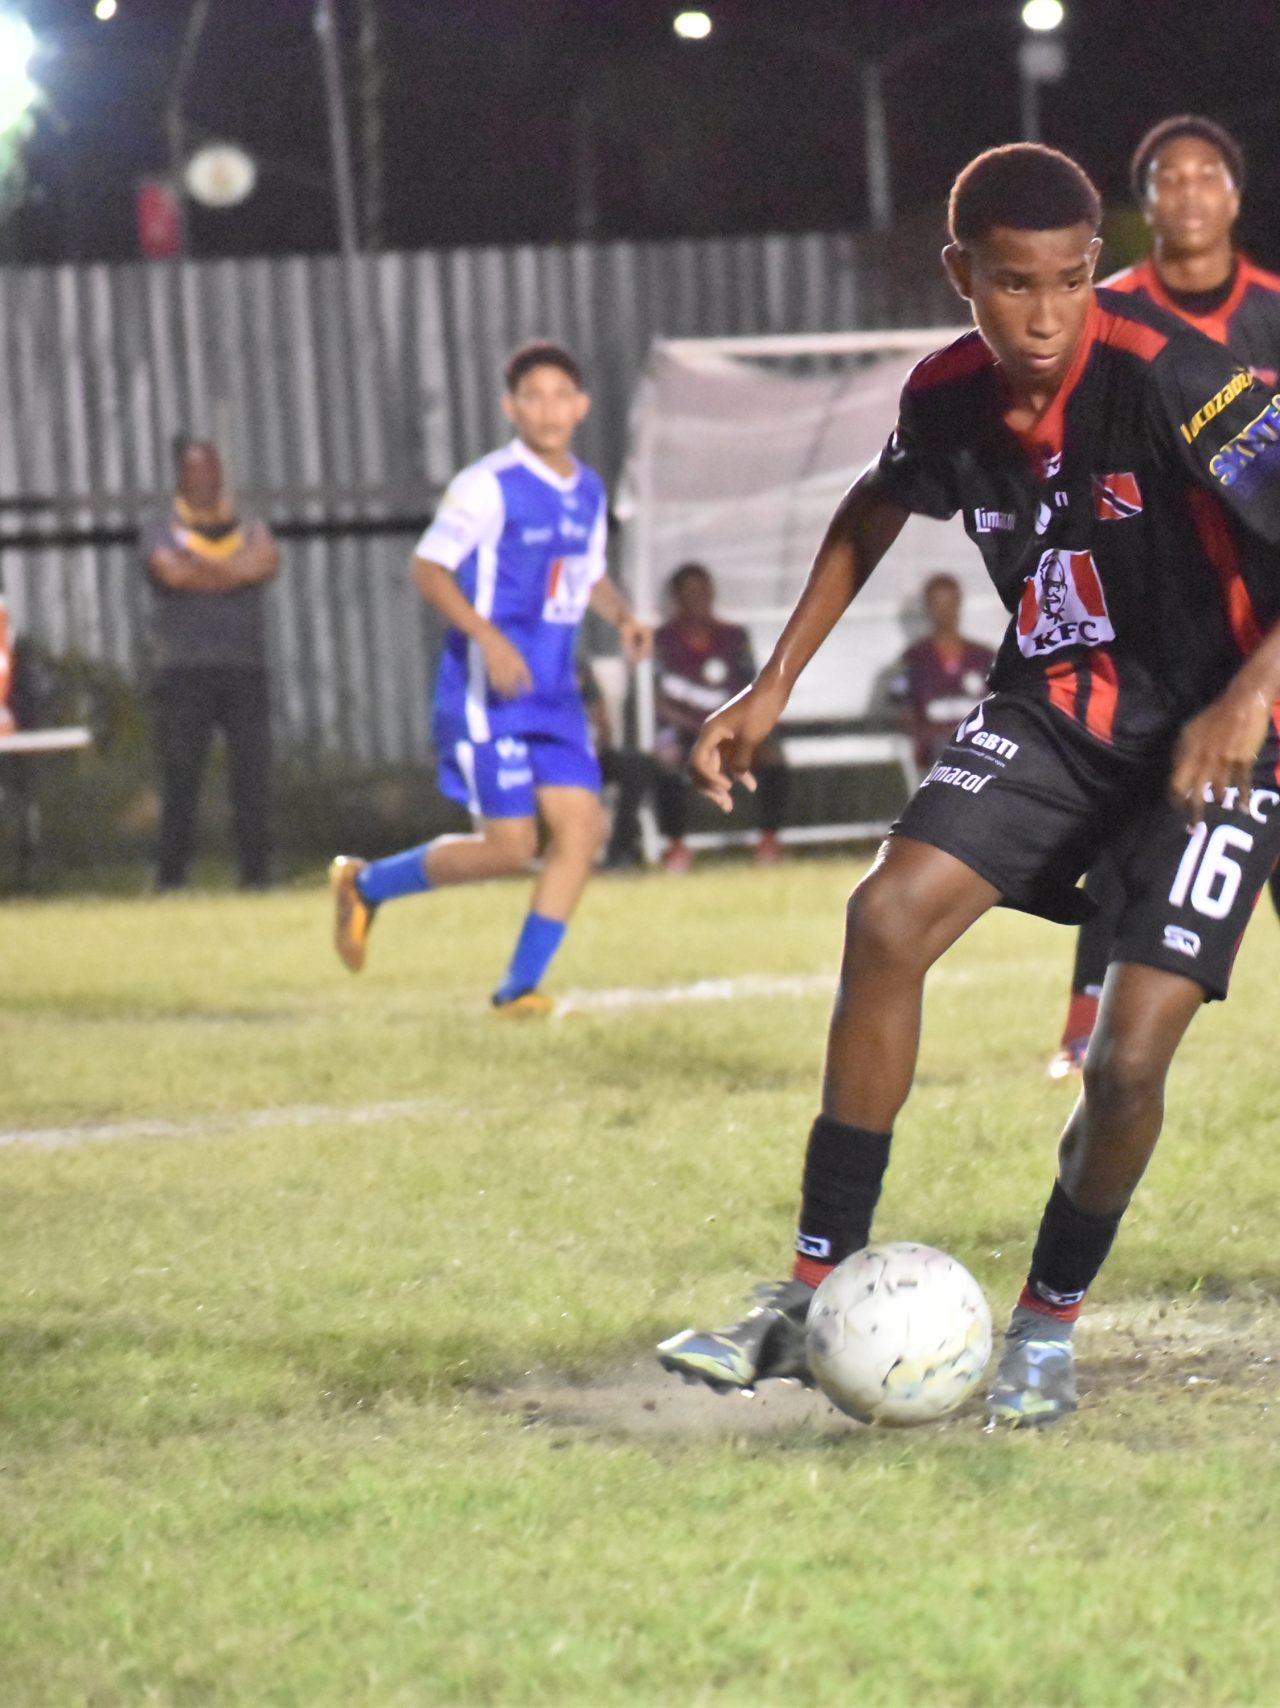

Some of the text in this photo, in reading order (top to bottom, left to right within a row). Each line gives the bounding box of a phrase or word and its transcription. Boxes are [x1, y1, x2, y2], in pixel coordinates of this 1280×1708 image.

[1032, 621, 1099, 651] KFC
[971, 731, 1020, 760] GBTI
[1168, 821, 1254, 921] 16
